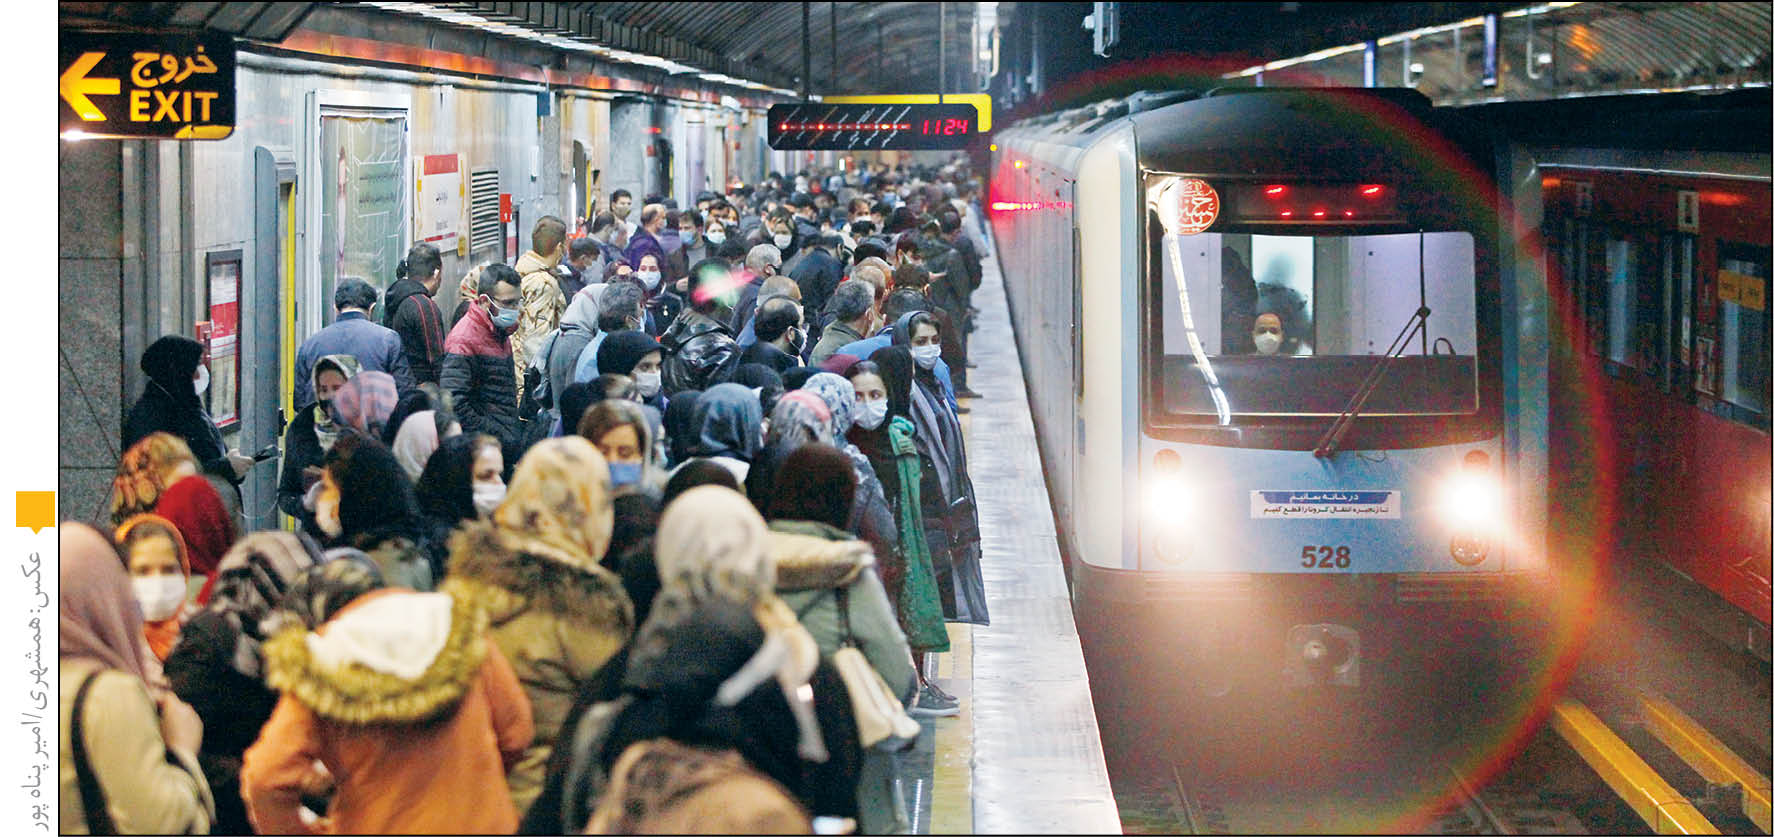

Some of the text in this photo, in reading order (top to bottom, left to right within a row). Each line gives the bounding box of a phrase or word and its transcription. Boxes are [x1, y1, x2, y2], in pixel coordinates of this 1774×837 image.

[131, 45, 218, 88] خروج
[130, 90, 219, 122] EXIT
[1289, 493, 1321, 503] بمانیم
[1322, 493, 1347, 501] خانه
[1302, 545, 1351, 569] 528
